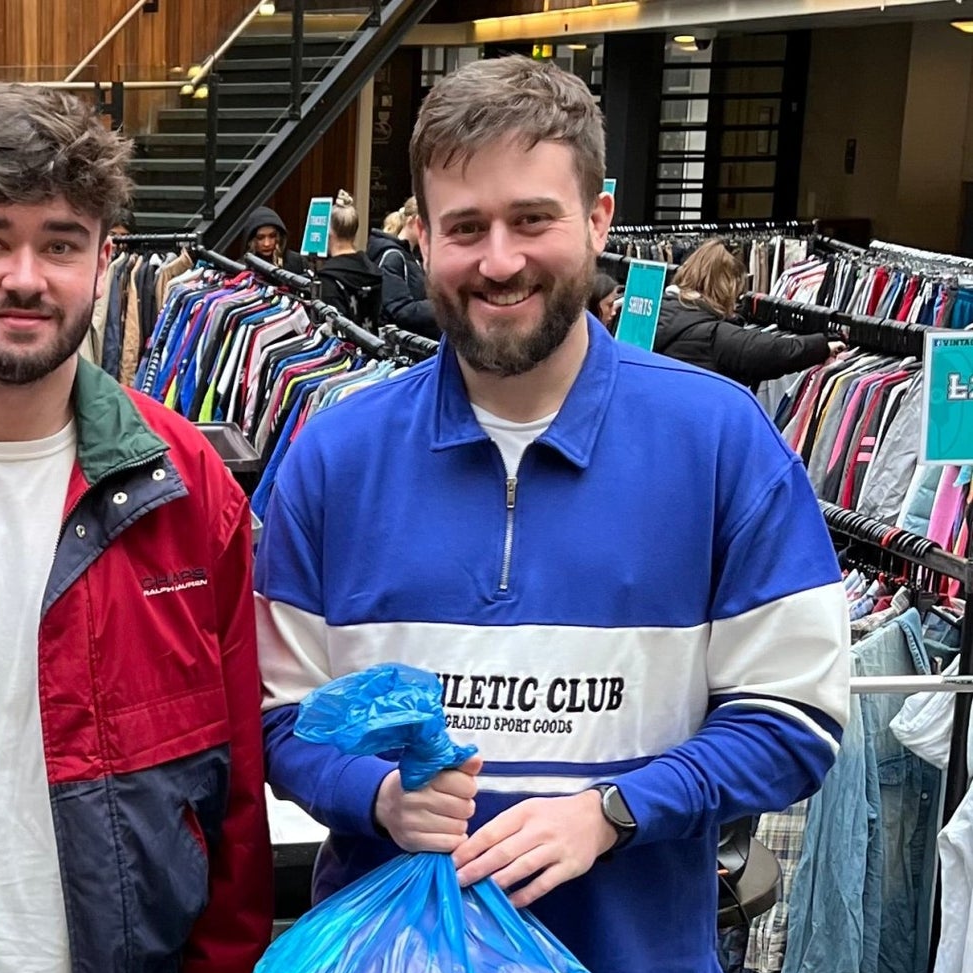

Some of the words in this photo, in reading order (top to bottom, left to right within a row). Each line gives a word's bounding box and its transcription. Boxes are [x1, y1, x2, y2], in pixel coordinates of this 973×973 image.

[628, 296, 654, 317] SHIRTS
[143, 585, 174, 597] RALPH
[547, 677, 625, 713] CLUB
[445, 714, 490, 731] GRADED
[493, 717, 531, 733] SPORT
[533, 719, 573, 734] GOODS
